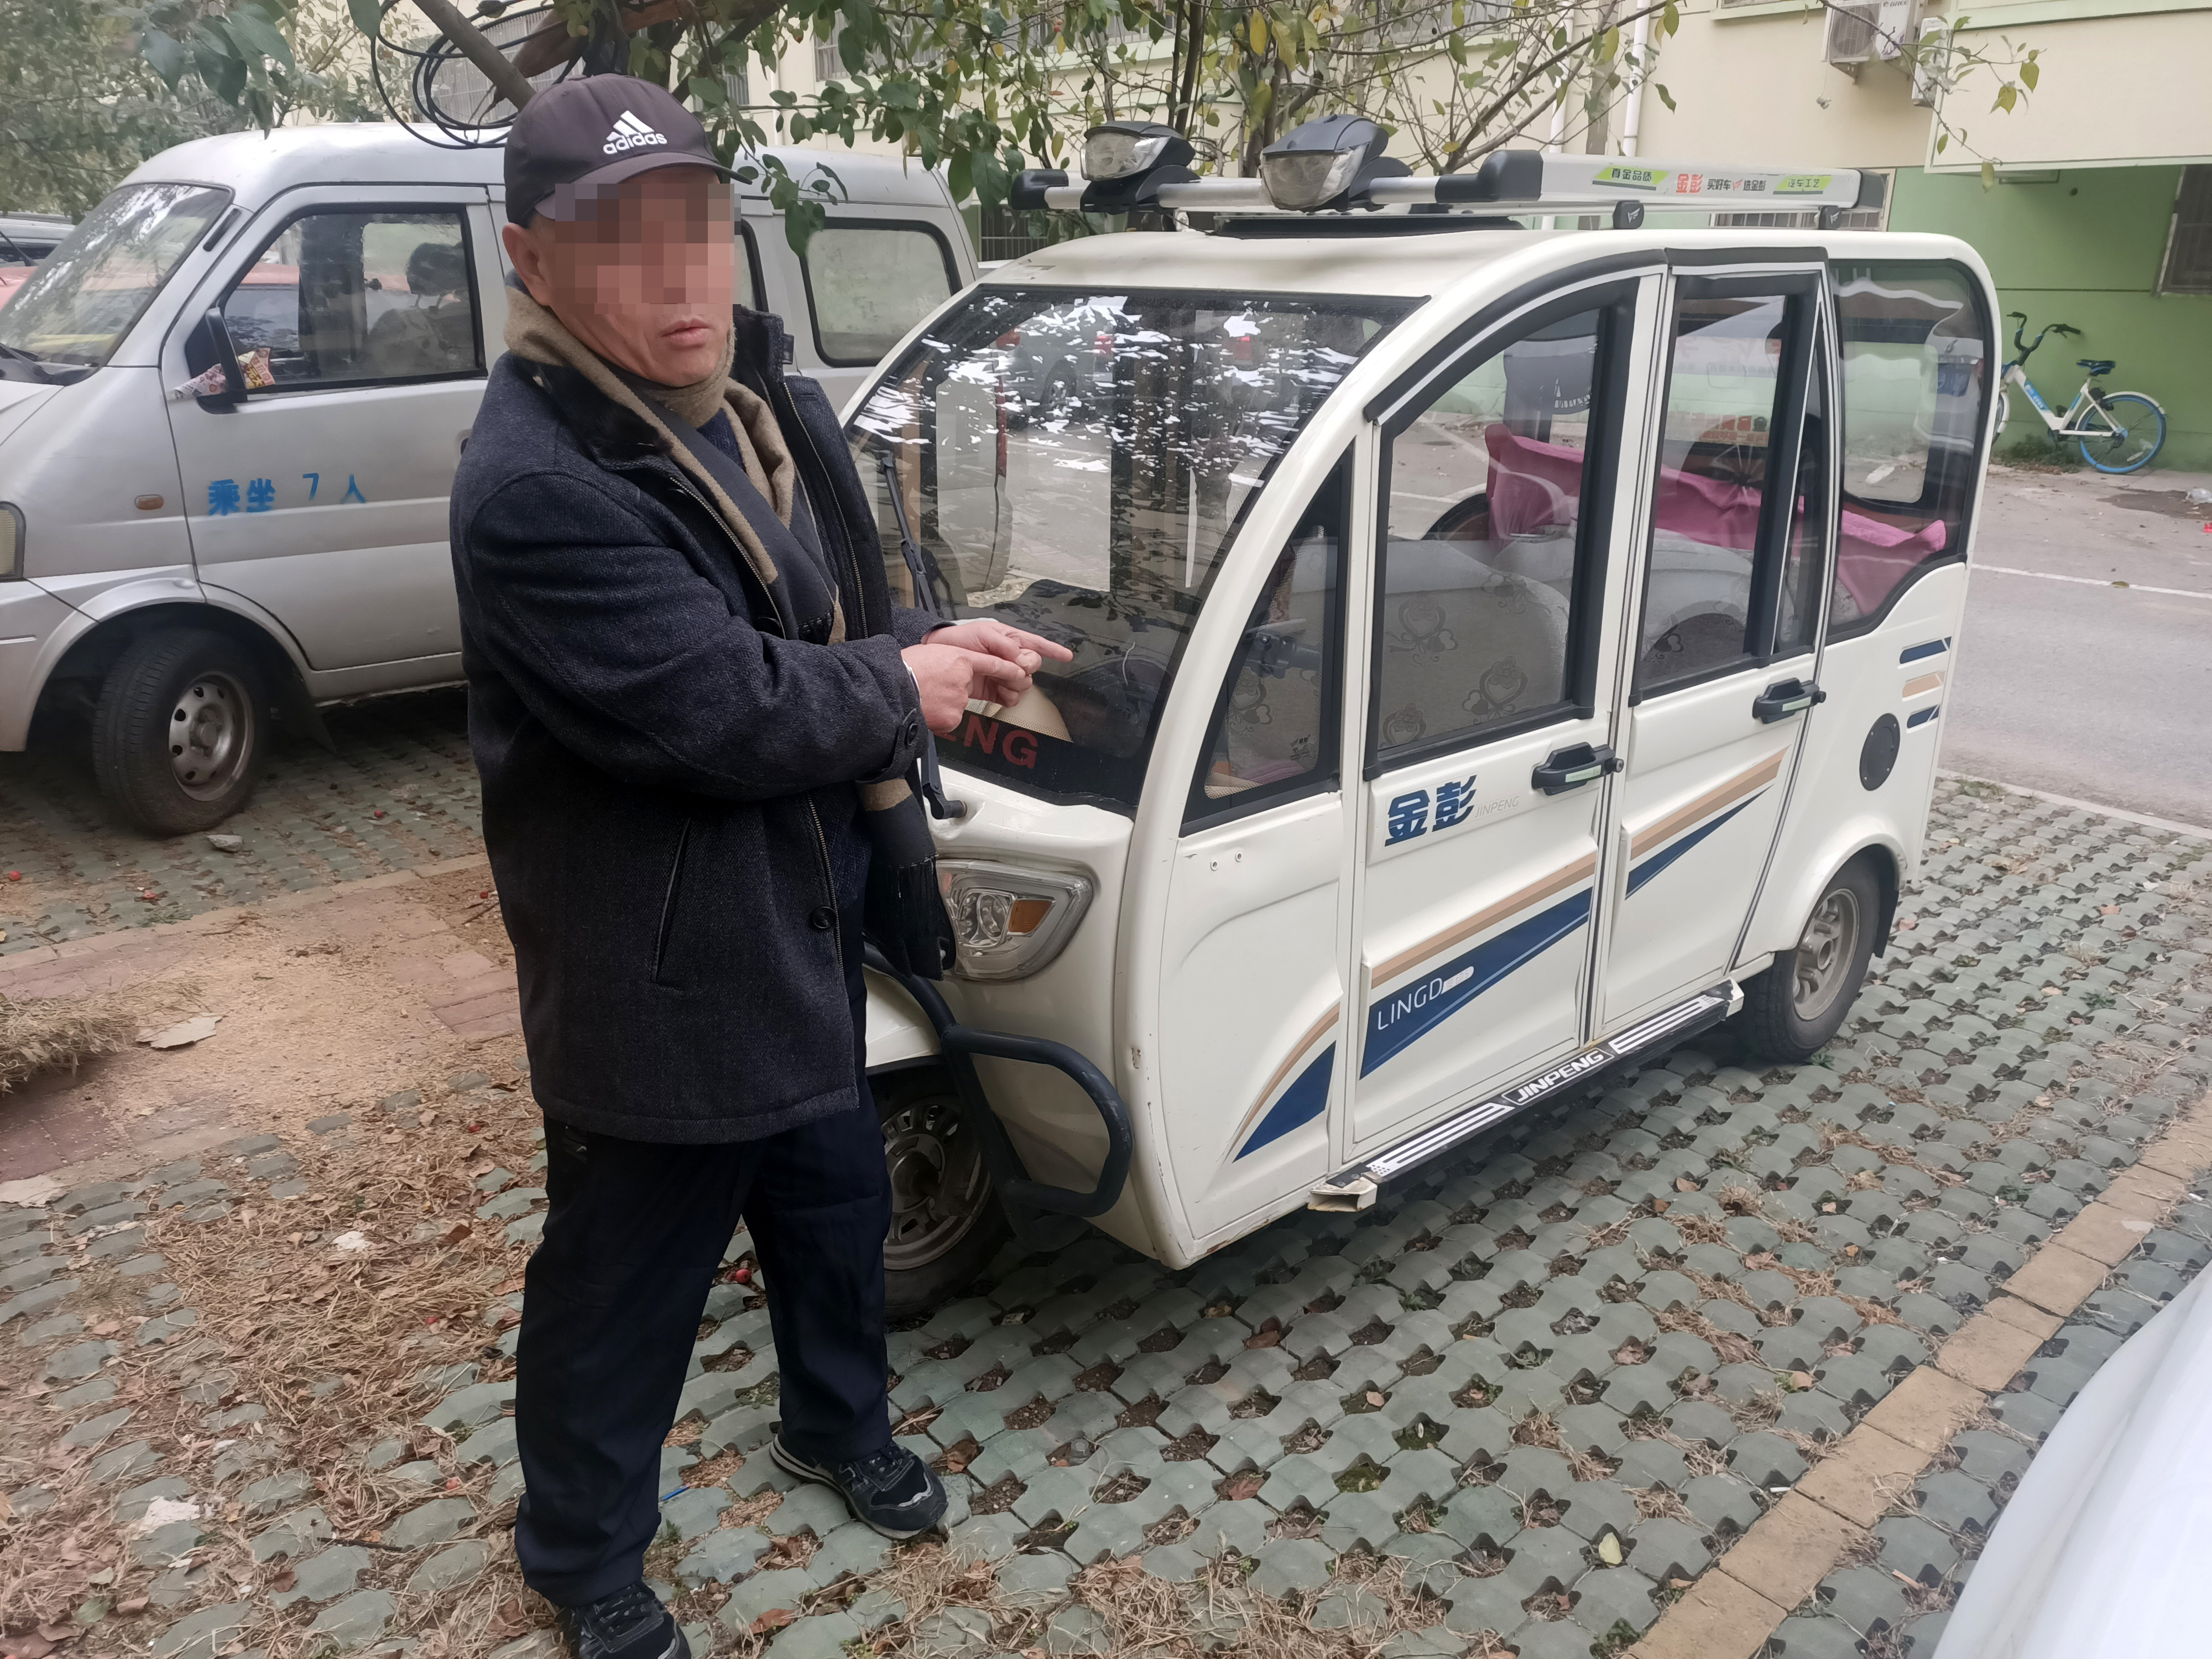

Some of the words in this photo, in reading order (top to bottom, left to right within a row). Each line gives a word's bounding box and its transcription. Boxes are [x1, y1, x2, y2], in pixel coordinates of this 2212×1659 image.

[603, 132, 667, 154] adidas
[1676, 173, 1703, 193] 金彭
[1743, 179, 1766, 191] 选金彭
[1787, 179, 1820, 187] 汽车工艺
[208, 478, 275, 515] 乘坐
[302, 473, 319, 501] 7
[340, 473, 366, 504] 人
[935, 715, 1038, 769] NG
[1384, 774, 1477, 847] 金彭
[1475, 796, 1520, 818] JINPENG
[1517, 1050, 1604, 1102] JINPENG
